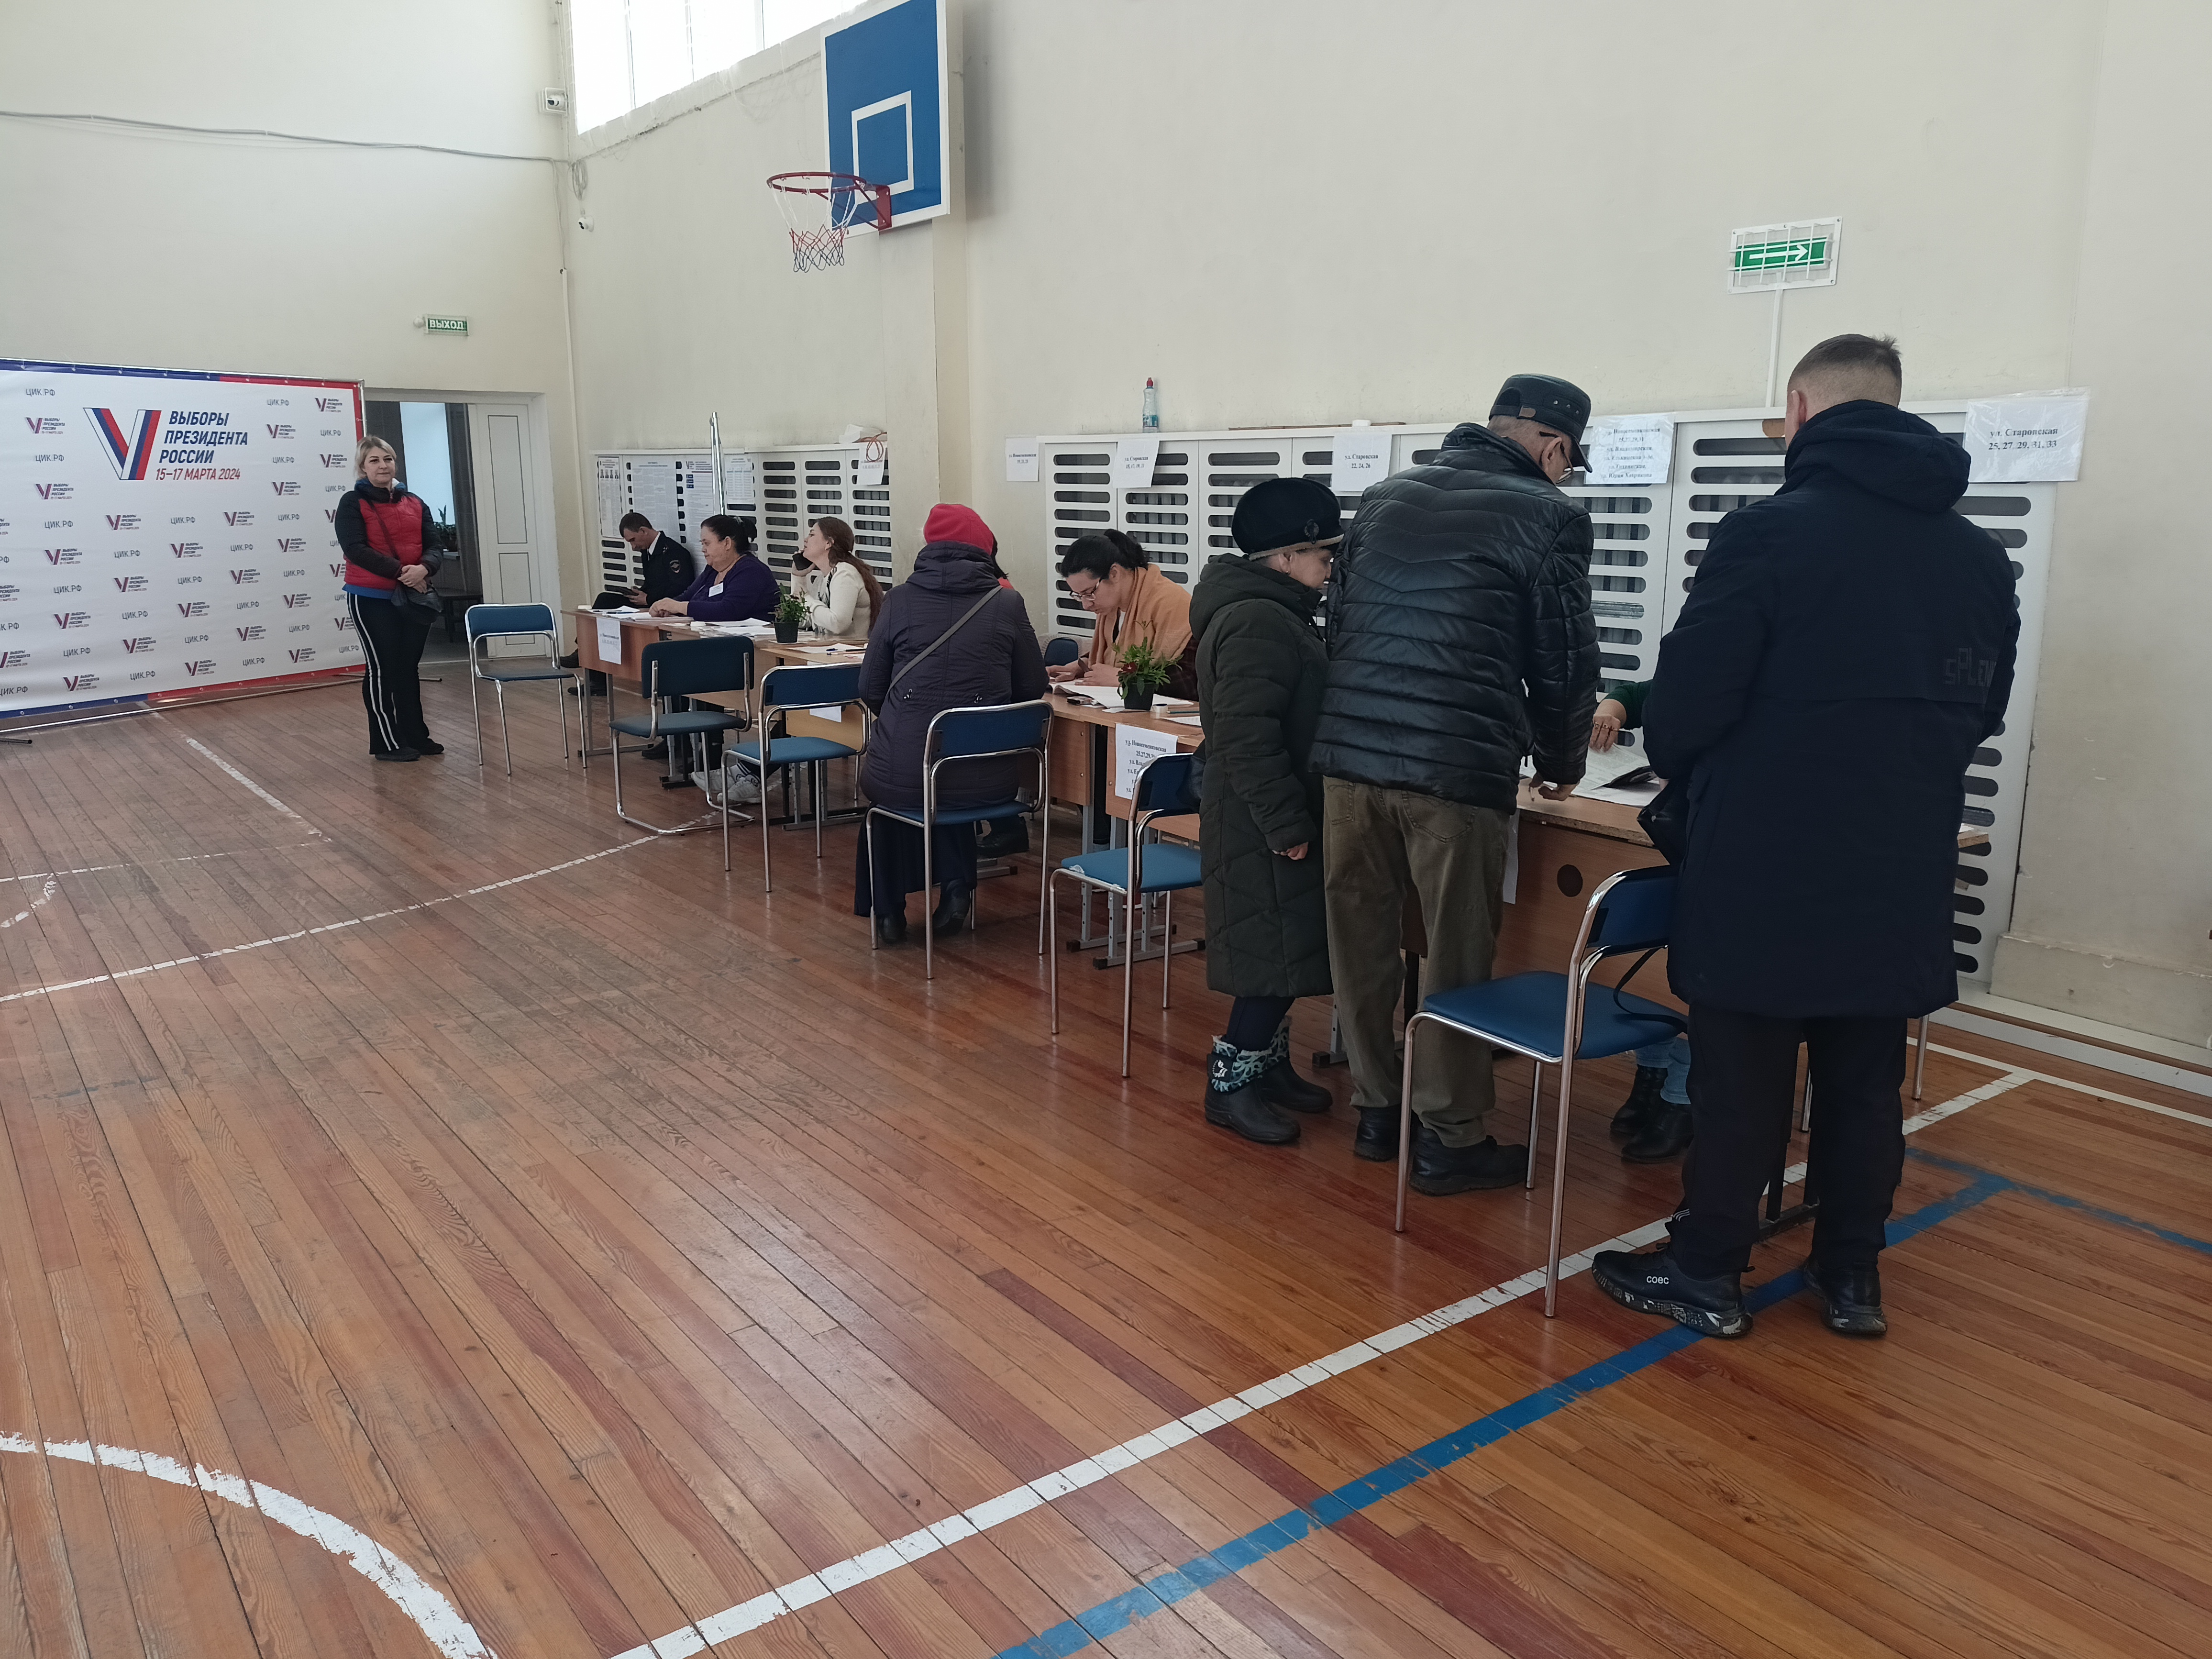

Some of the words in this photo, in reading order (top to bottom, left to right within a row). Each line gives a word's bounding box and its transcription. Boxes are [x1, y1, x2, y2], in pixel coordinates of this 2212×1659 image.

[430, 320, 464, 330] ВЫХОД
[169, 411, 230, 426] ВЫБОРЫ
[164, 430, 248, 447] ПРЕЗИДЕНТА
[2005, 429, 2058, 437] Старовская
[159, 450, 214, 463] РОССИИ
[184, 468, 216, 480] МАРТА
[219, 468, 241, 480] 2024
